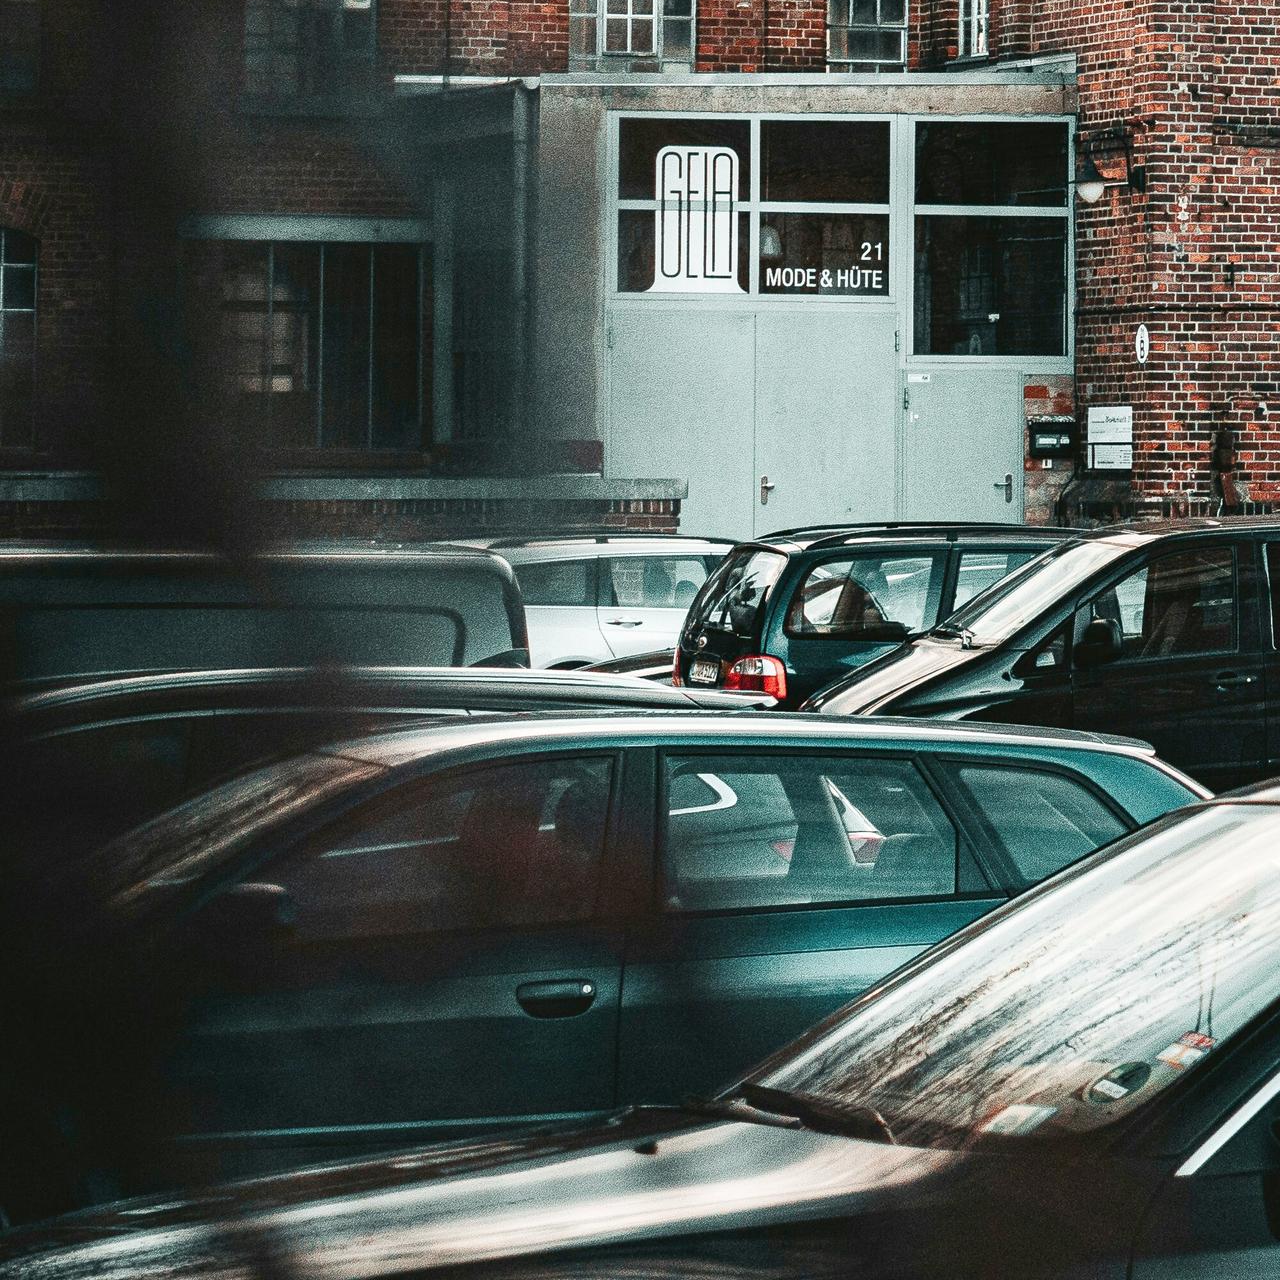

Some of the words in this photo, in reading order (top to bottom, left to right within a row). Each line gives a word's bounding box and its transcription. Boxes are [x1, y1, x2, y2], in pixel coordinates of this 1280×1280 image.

[661, 152, 733, 279] GELA
[861, 242, 882, 260] 21
[766, 267, 816, 287] MODE
[820, 268, 833, 288] &
[837, 265, 883, 288] HÜTE
